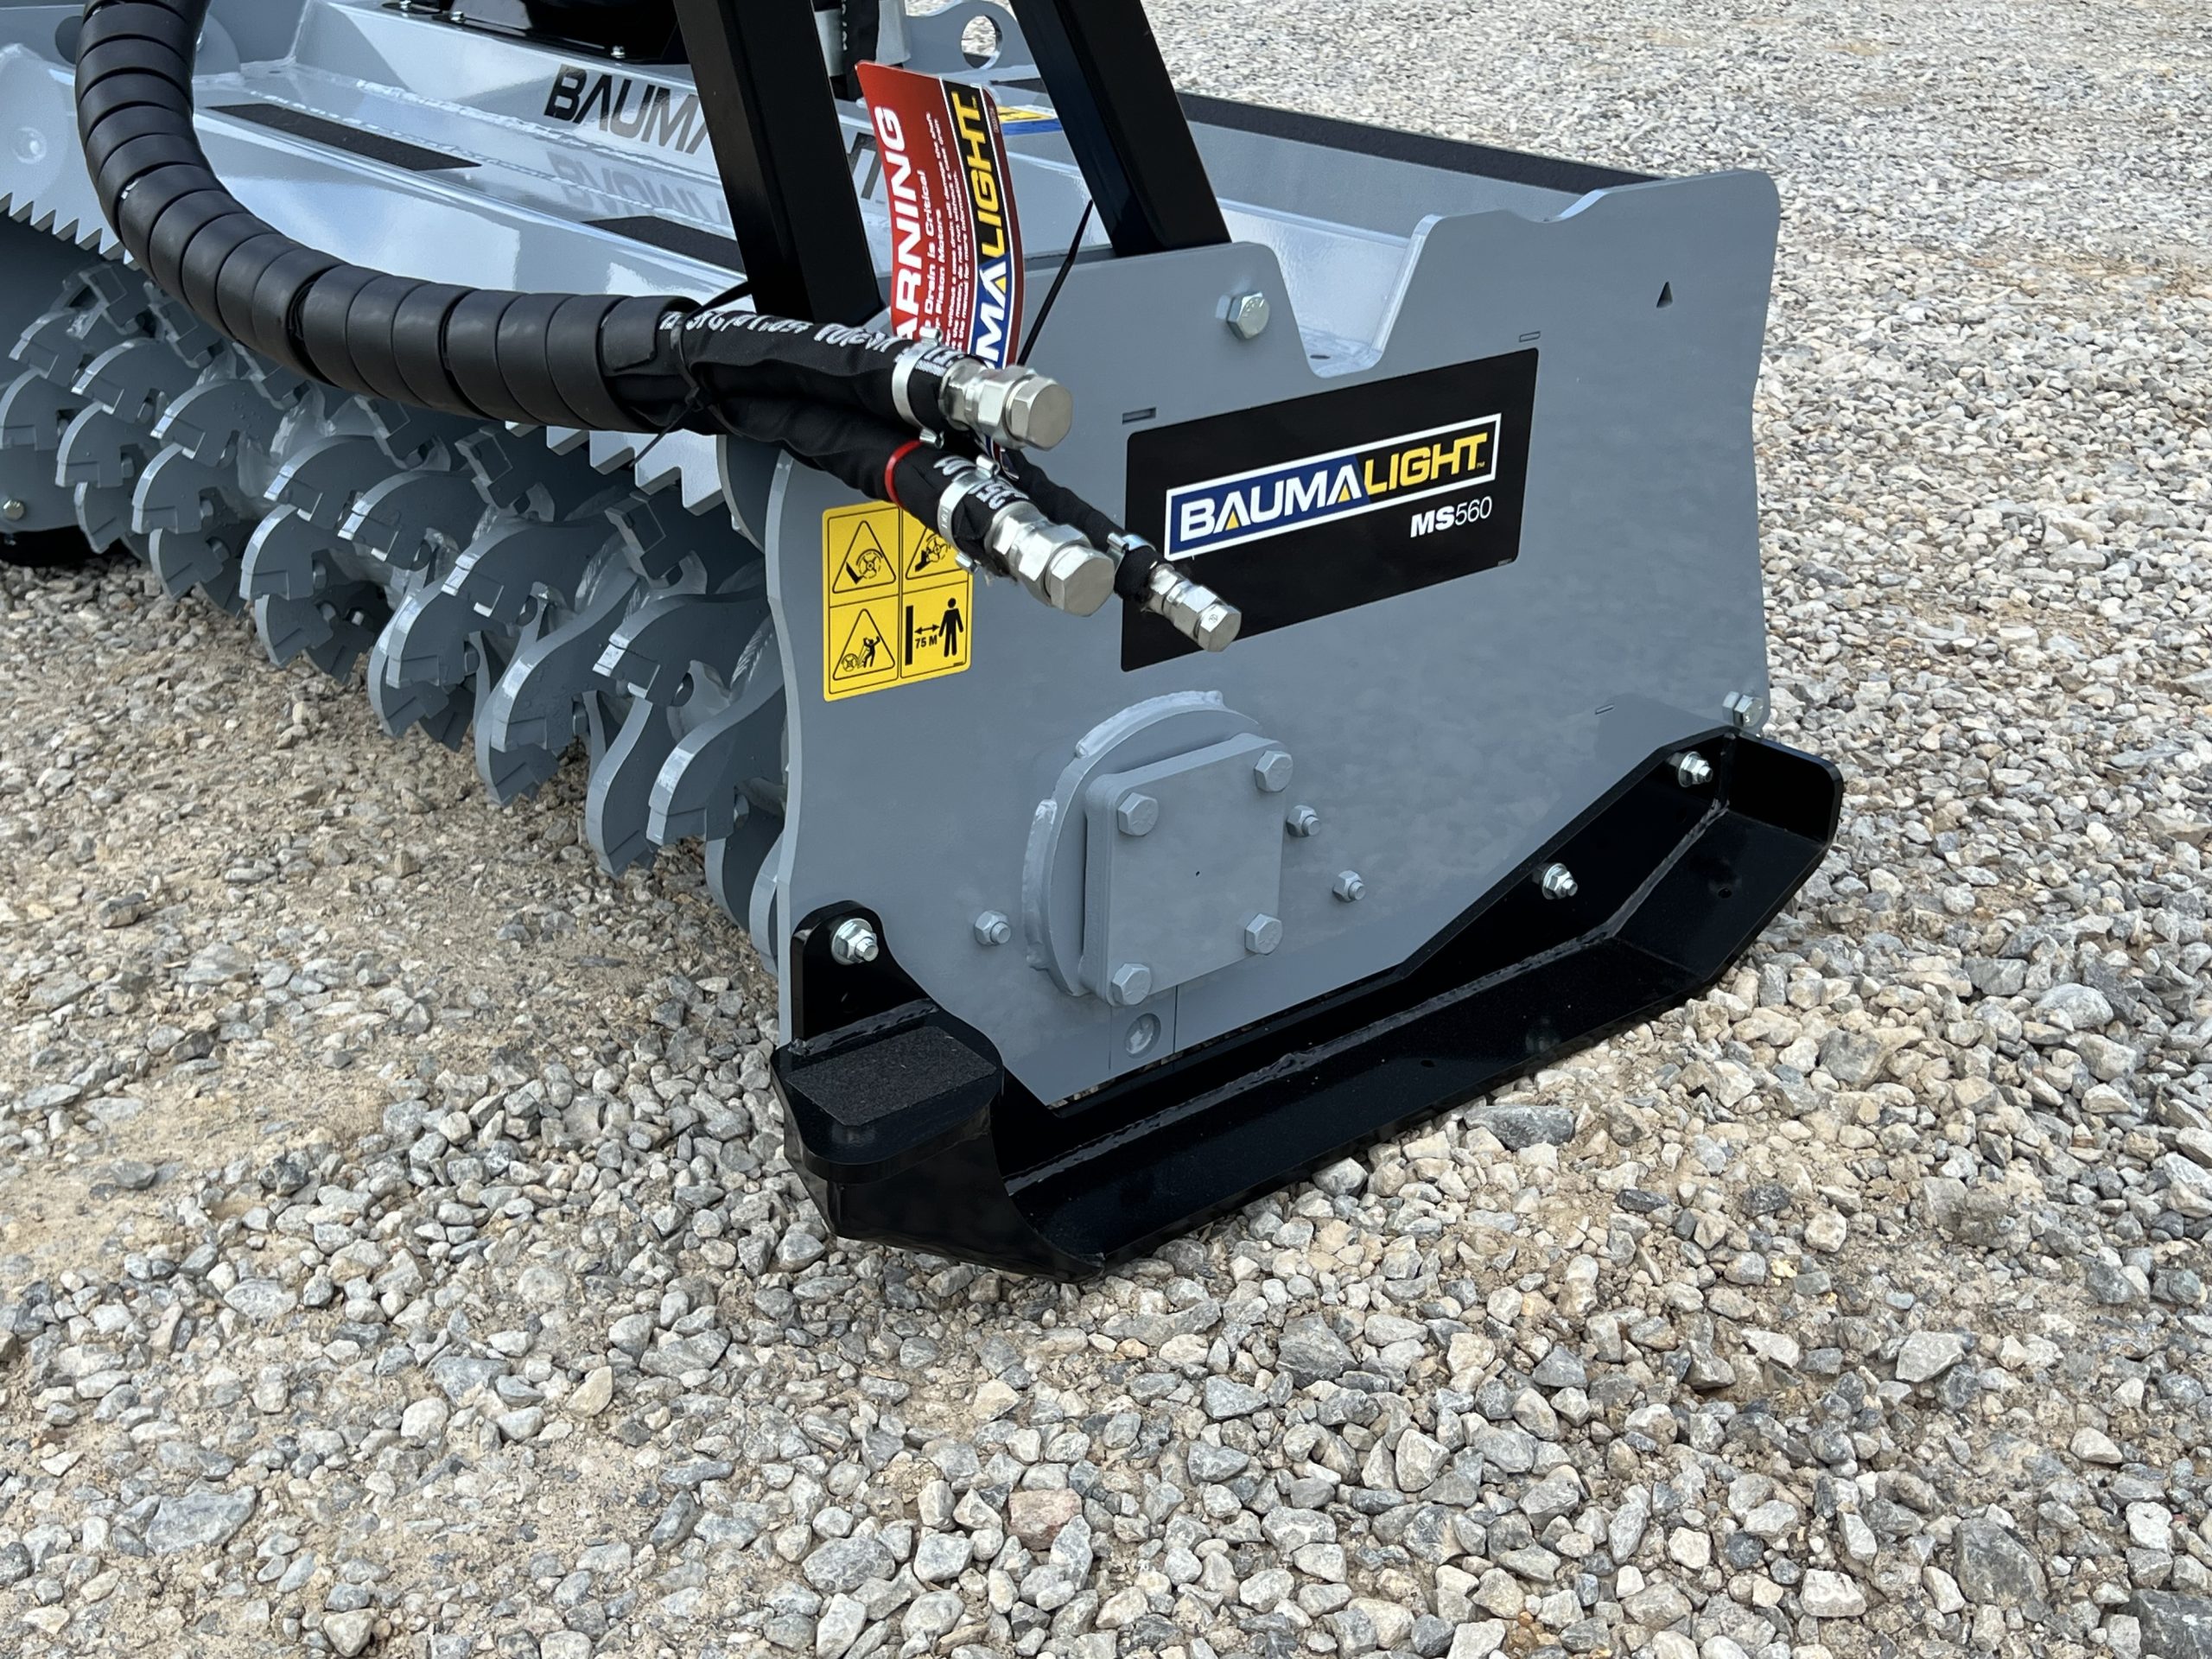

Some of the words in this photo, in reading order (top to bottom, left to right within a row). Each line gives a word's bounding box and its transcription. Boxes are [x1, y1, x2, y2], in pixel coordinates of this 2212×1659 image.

[917, 169, 934, 237] Critical
[938, 161, 950, 200] damage
[874, 106, 922, 340] ARNING
[935, 208, 945, 263] Motors
[950, 92, 1006, 366] MALIGHT
[927, 242, 936, 258] is
[924, 264, 936, 315] Drain
[935, 266, 945, 315] Piston
[1179, 433, 1487, 542] BAUMALIGHT
[1410, 496, 1492, 537] MS560
[914, 637, 927, 649] 75
[929, 634, 938, 646] M
